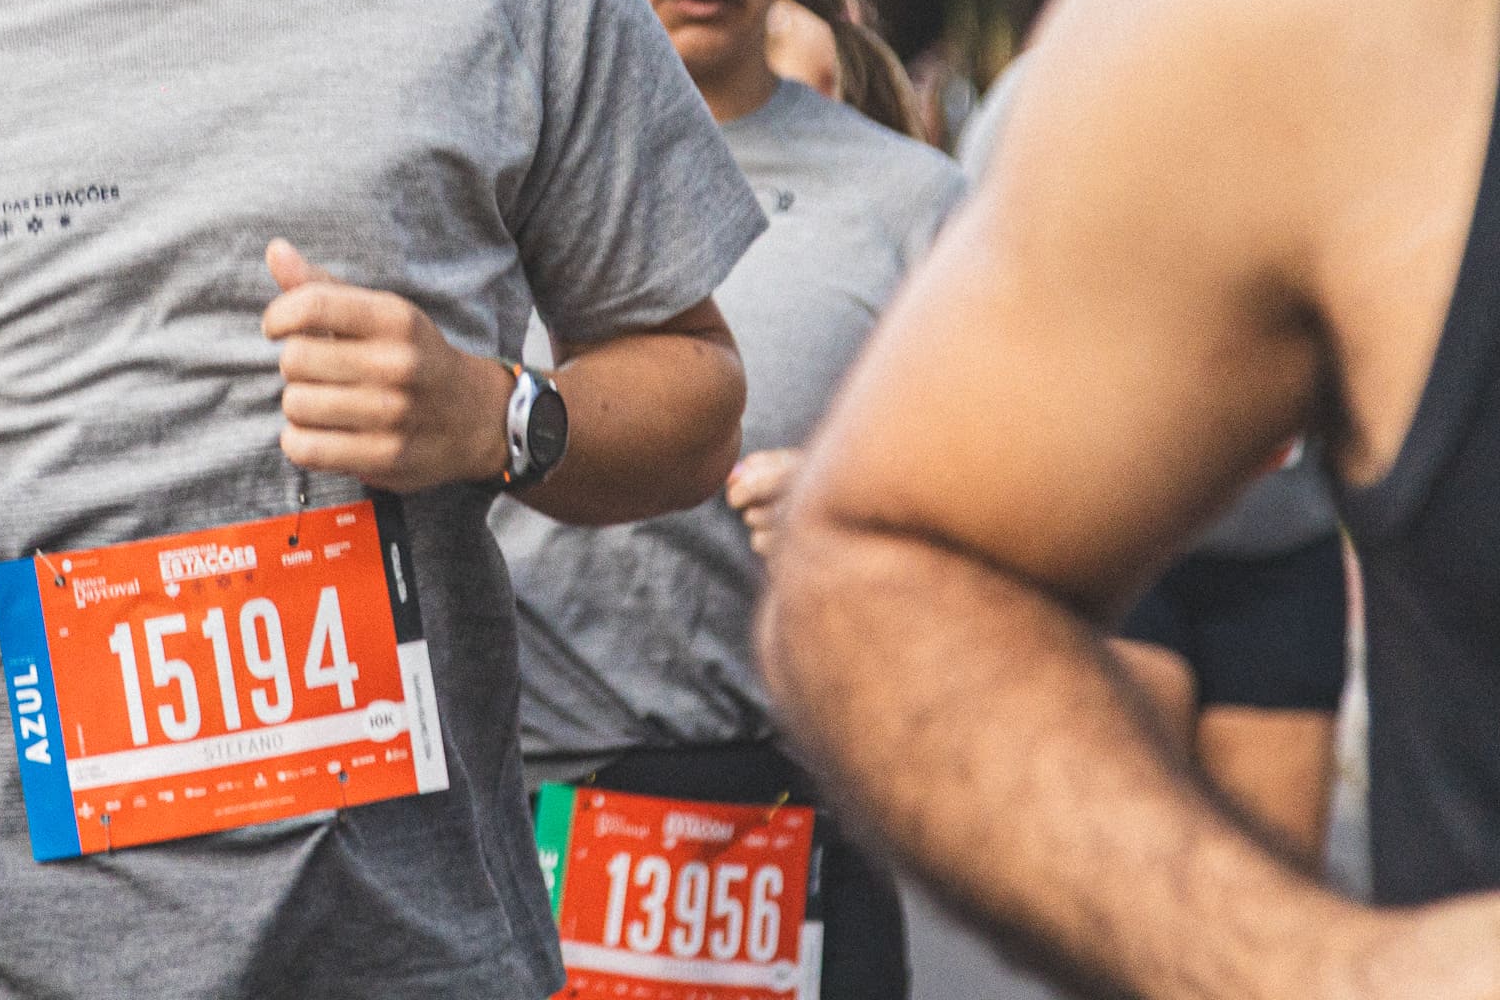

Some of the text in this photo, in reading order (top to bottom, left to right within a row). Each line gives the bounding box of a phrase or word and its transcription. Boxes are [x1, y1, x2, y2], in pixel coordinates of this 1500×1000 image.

[3, 199, 30, 214] DAS
[34, 184, 120, 209] ESTAÇÕES
[13, 664, 52, 765] AZUL
[108, 586, 360, 747] 15194
[604, 852, 785, 963] 13956
